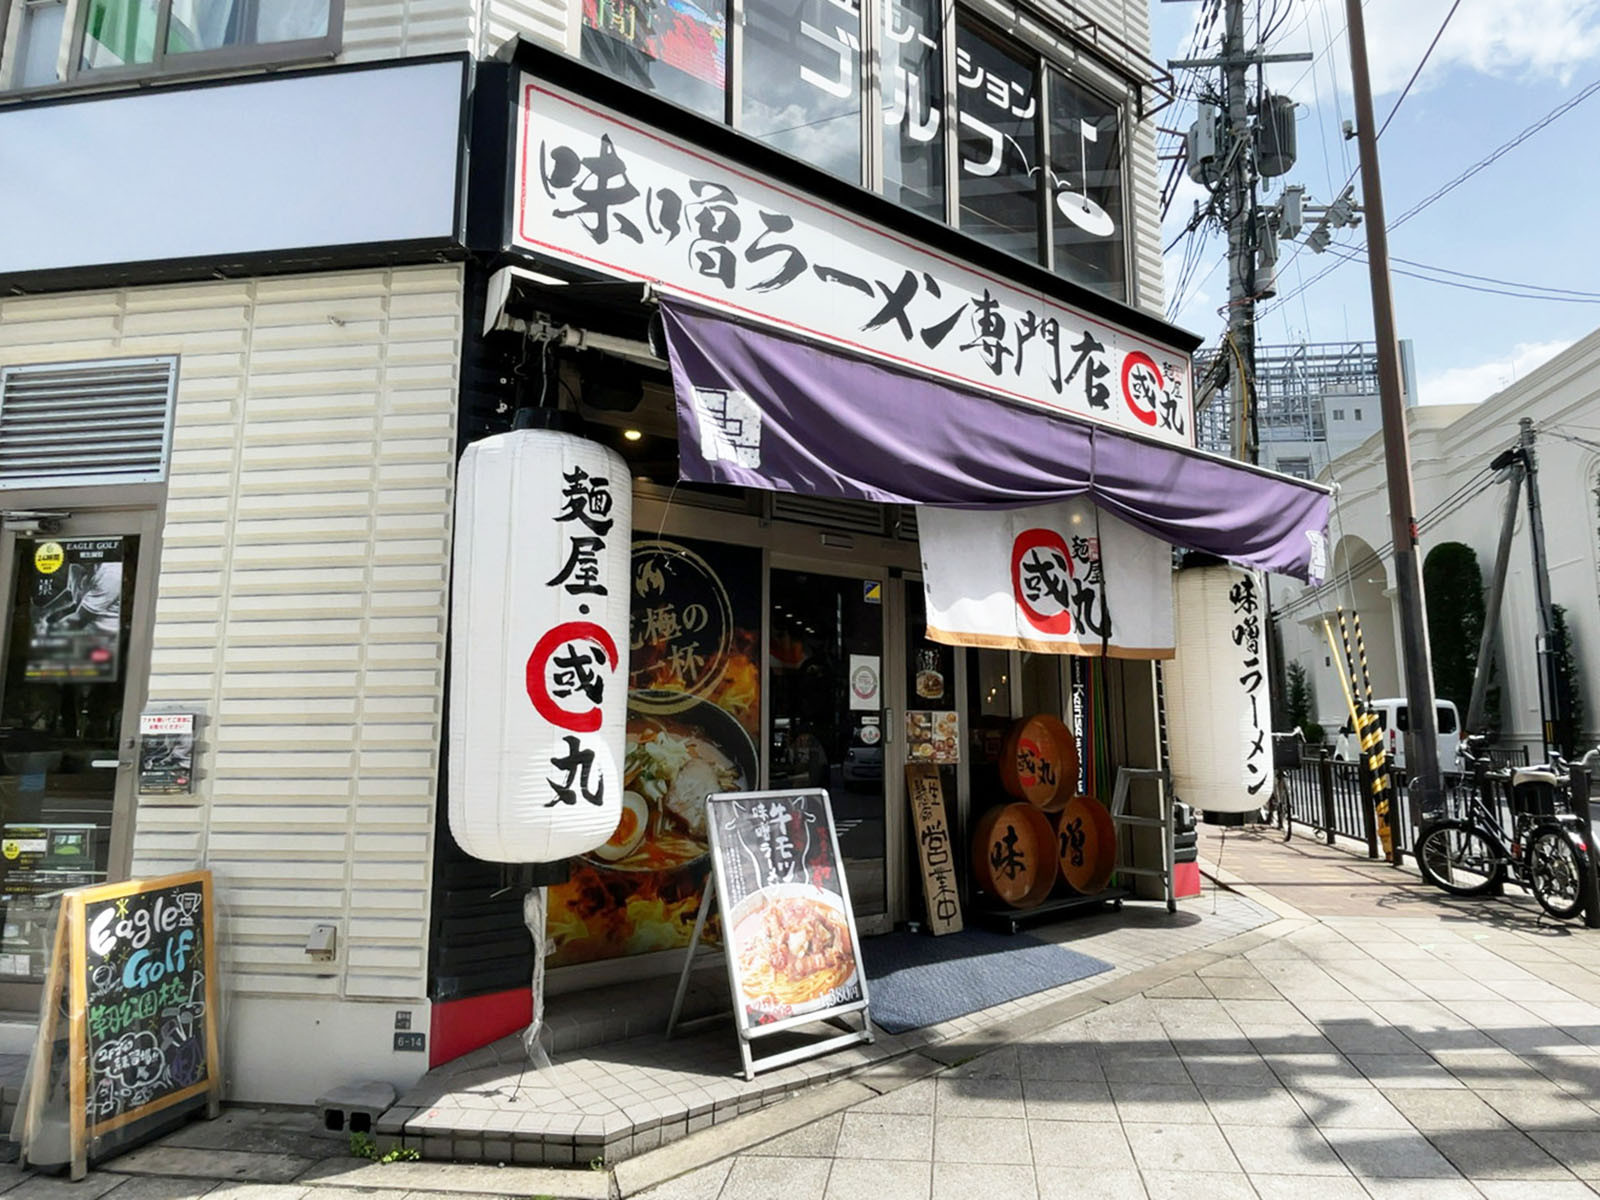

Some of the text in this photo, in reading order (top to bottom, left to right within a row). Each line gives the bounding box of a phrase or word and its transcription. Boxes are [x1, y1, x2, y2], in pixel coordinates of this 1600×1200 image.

[800, 20, 1004, 177] ゴルフ
[539, 132, 1111, 413] 味噌ラーメン専門店
[65, 541, 120, 551] EAGLE GOLF
[1229, 574, 1268, 797] 味噌ラーメン
[769, 802, 796, 883] 牛モツ
[921, 820, 958, 927] 営業中
[89, 896, 178, 957] Eagle
[122, 928, 195, 990] Golf
[397, 1036, 422, 1048] 6-14
